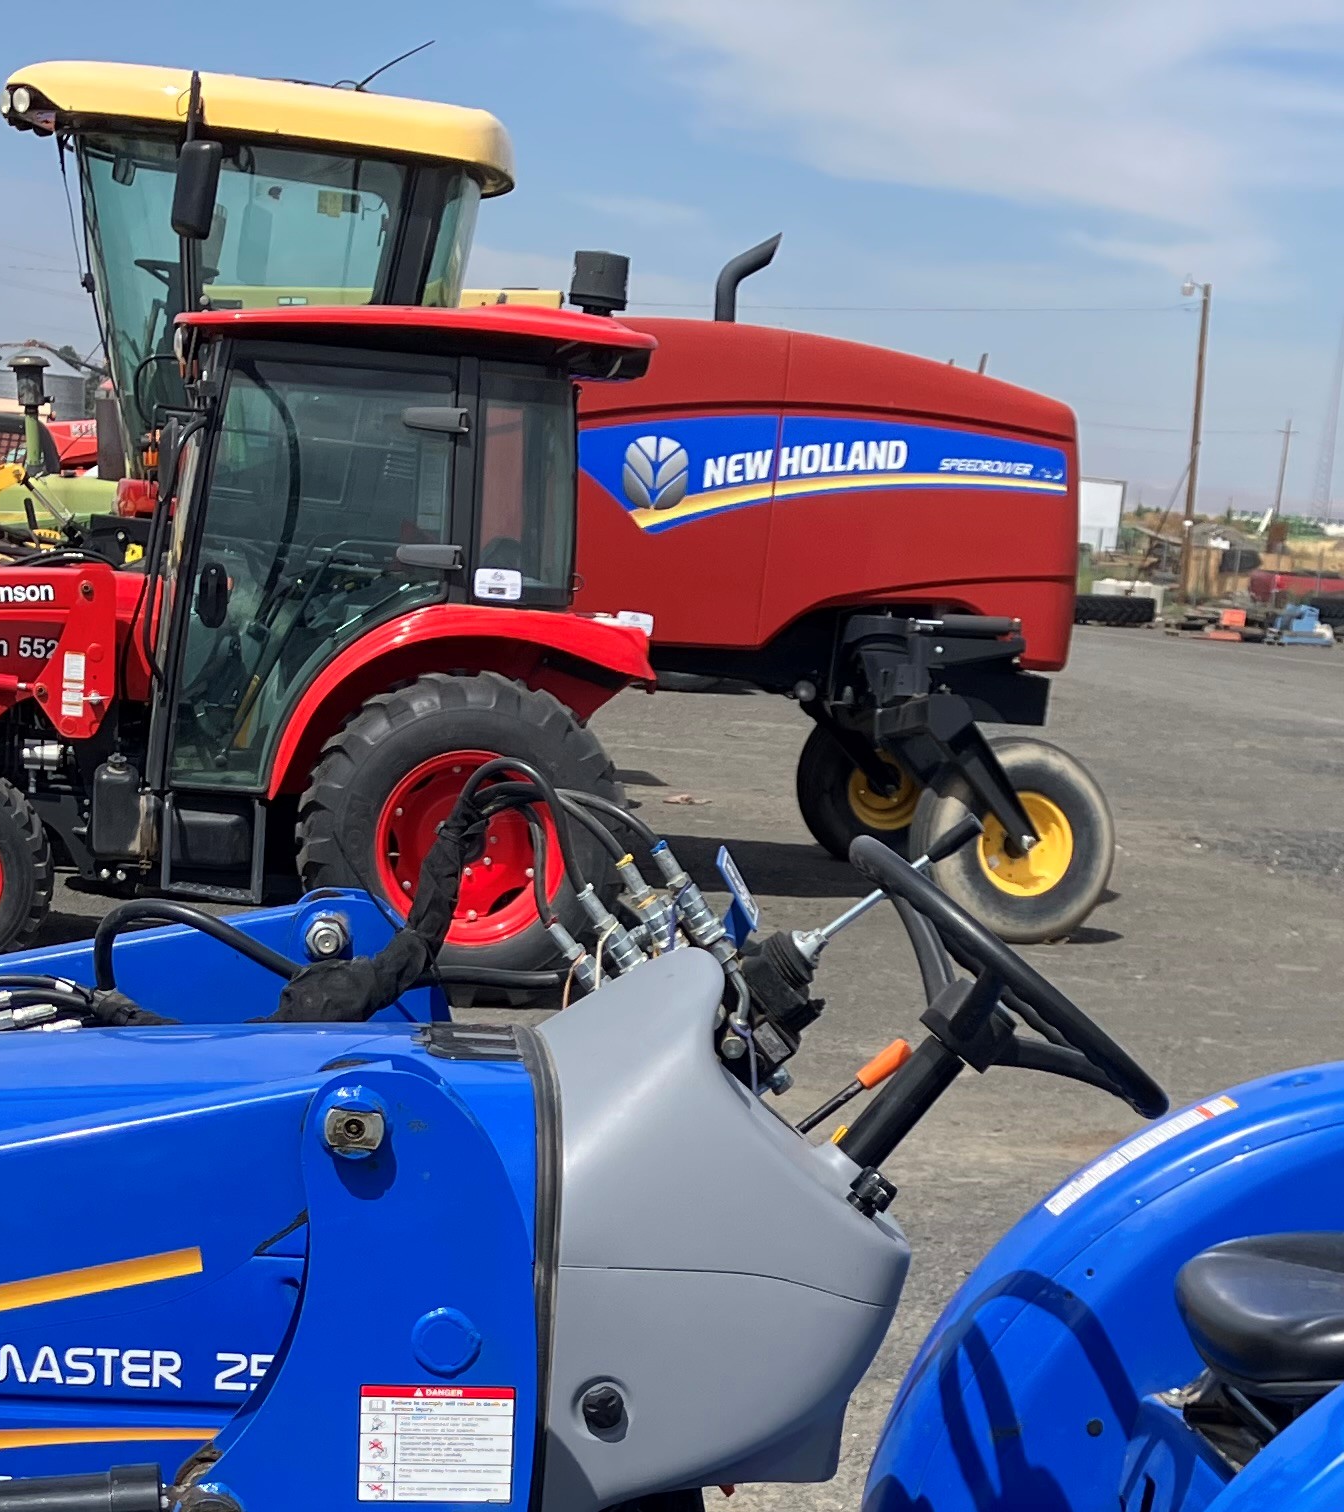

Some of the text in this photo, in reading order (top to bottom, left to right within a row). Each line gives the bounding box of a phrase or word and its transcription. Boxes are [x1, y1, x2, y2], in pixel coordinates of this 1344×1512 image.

[702, 441, 908, 487] NEW HOLLAND
[939, 458, 1033, 476] SPEEDROWER
